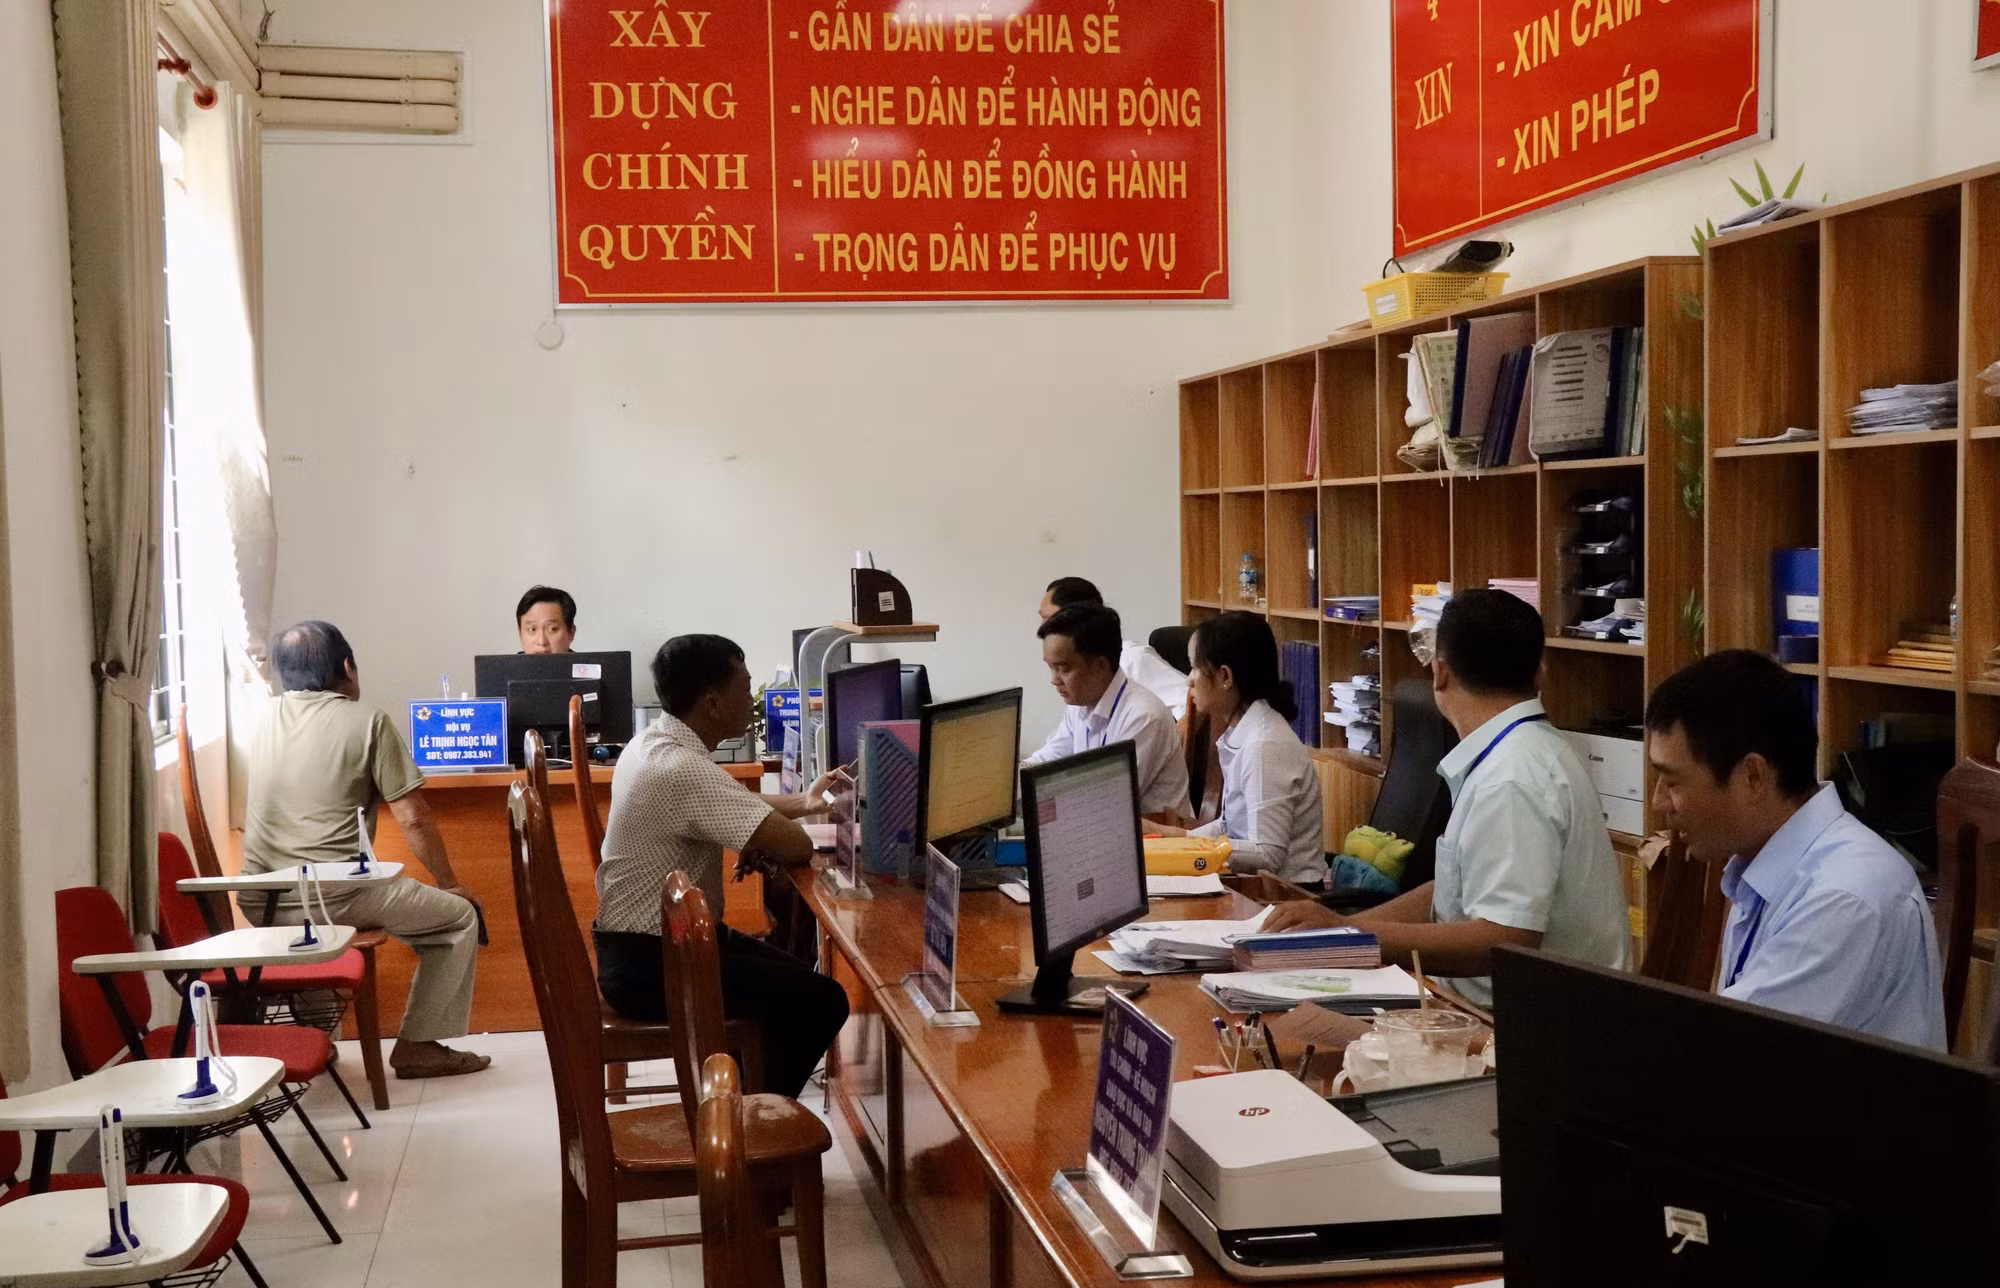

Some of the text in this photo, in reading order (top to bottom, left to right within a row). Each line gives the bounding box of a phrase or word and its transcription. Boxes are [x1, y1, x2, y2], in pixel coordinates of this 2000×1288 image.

[609, 0, 711, 48] XÂY
[883, 1, 944, 52] DÂN
[1004, 13, 1074, 53] CHIA
[1083, 0, 1120, 54] SẺ
[1512, 8, 1560, 78] XIN
[588, 76, 738, 130] DỰNG
[810, 85, 895, 126] NGHE
[906, 75, 966, 126] DÂN
[977, 64, 1016, 126] ĐỂ
[1027, 76, 1107, 127] HÀNH
[1118, 77, 1201, 136] ĐỘNG
[1414, 61, 1453, 130] XIN
[1513, 110, 1559, 175] XIN
[1571, 63, 1660, 151] PHÉP
[582, 142, 749, 190] CHÍNH
[812, 137, 881, 199] HIỂU
[892, 149, 953, 199] DÂN
[963, 137, 1002, 199] ĐỂ
[1012, 142, 1097, 200] ĐỒNG
[1107, 149, 1187, 199] HÀNH
[579, 205, 756, 270] QUYỀN
[812, 232, 918, 281] TRỌNG
[929, 222, 989, 272] DÂN
[1000, 211, 1039, 271] ĐỂ
[1050, 232, 1128, 280] PHỤC
[1138, 233, 1176, 280] VỤ
[440, 706, 458, 717] LĨNH
[419, 733, 497, 750] LÊ TRỊNH NGỌC TÂN
[1244, 1107, 1267, 1117] hp
